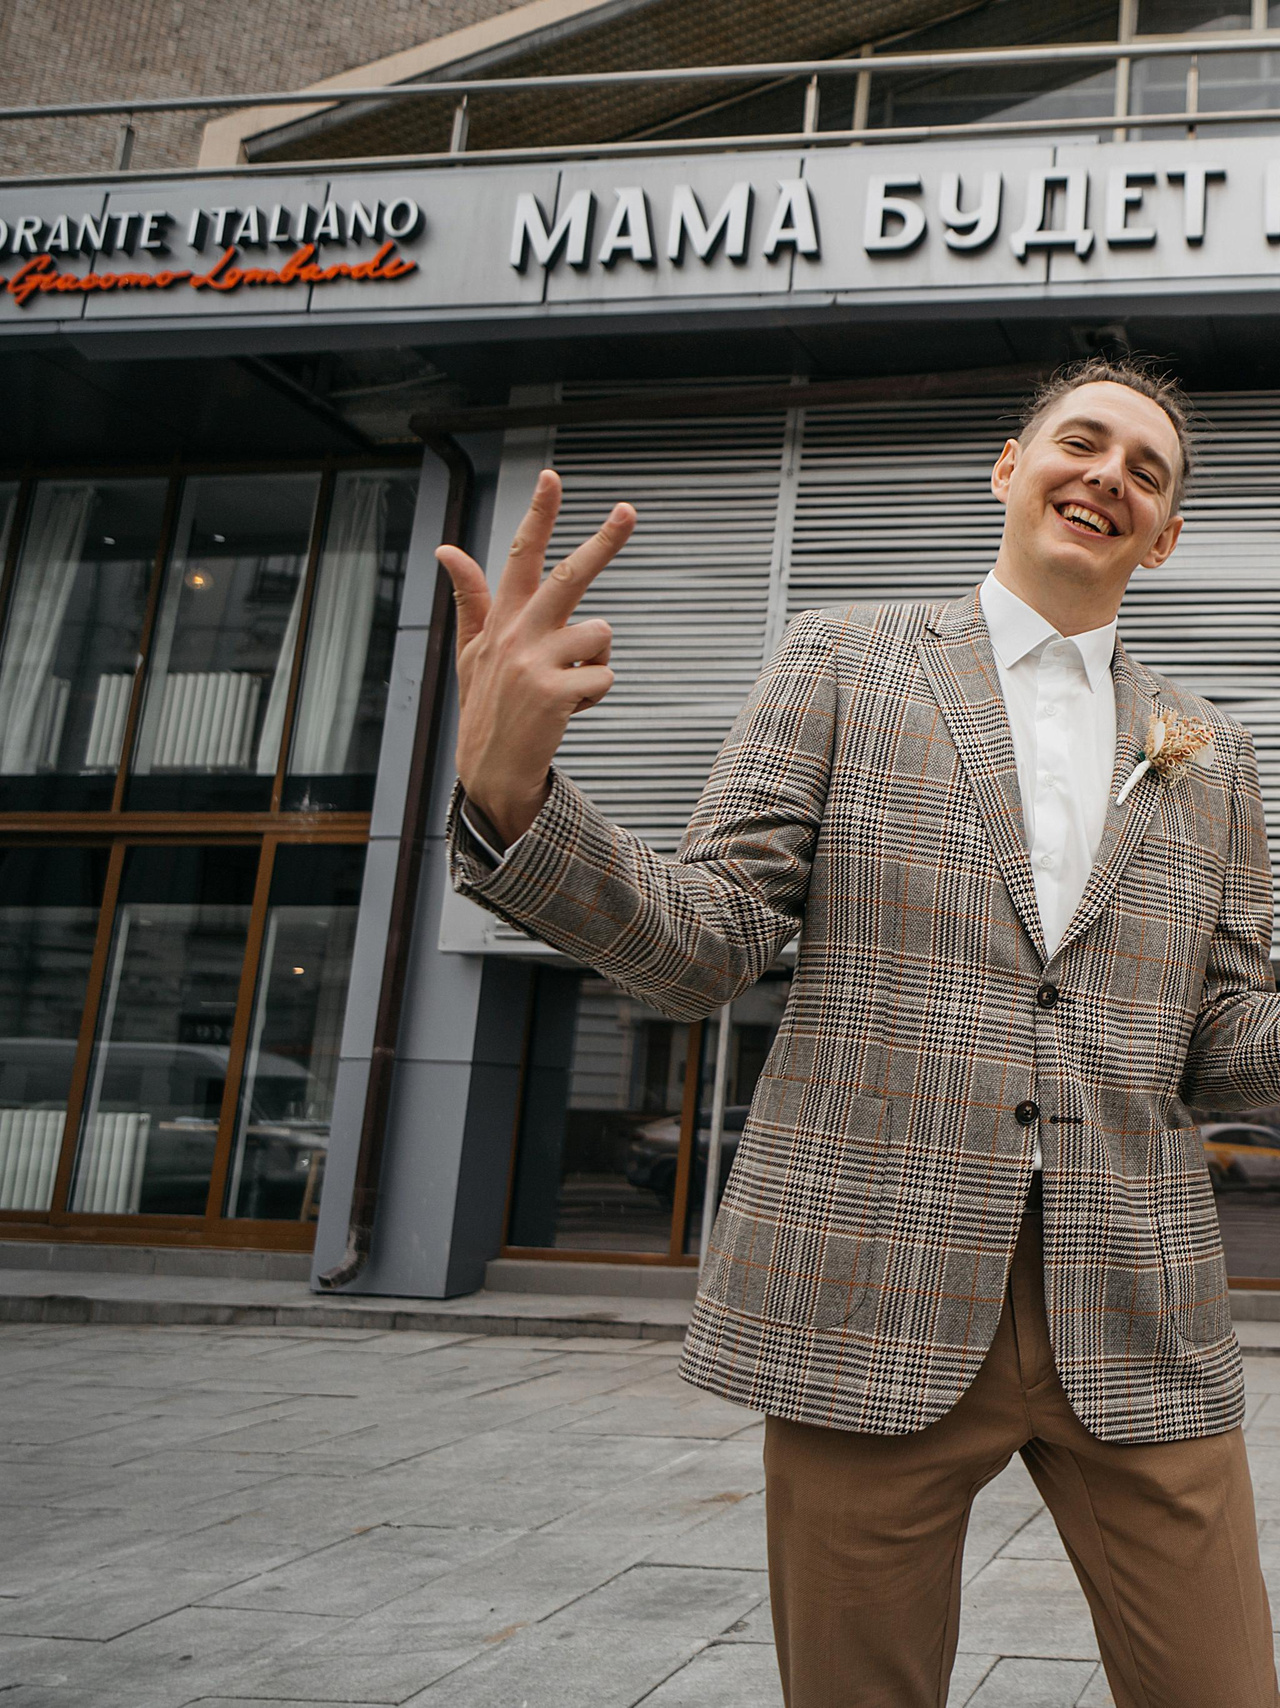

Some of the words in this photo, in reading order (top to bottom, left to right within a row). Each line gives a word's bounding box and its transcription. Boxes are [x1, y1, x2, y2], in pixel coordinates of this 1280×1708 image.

[0, 210, 172, 255] RANTE
[187, 196, 424, 252] ITALIANO
[509, 178, 820, 271] МАМА
[863, 167, 1226, 261] БУДЕТ
[190, 240, 418, 291] Lombardi
